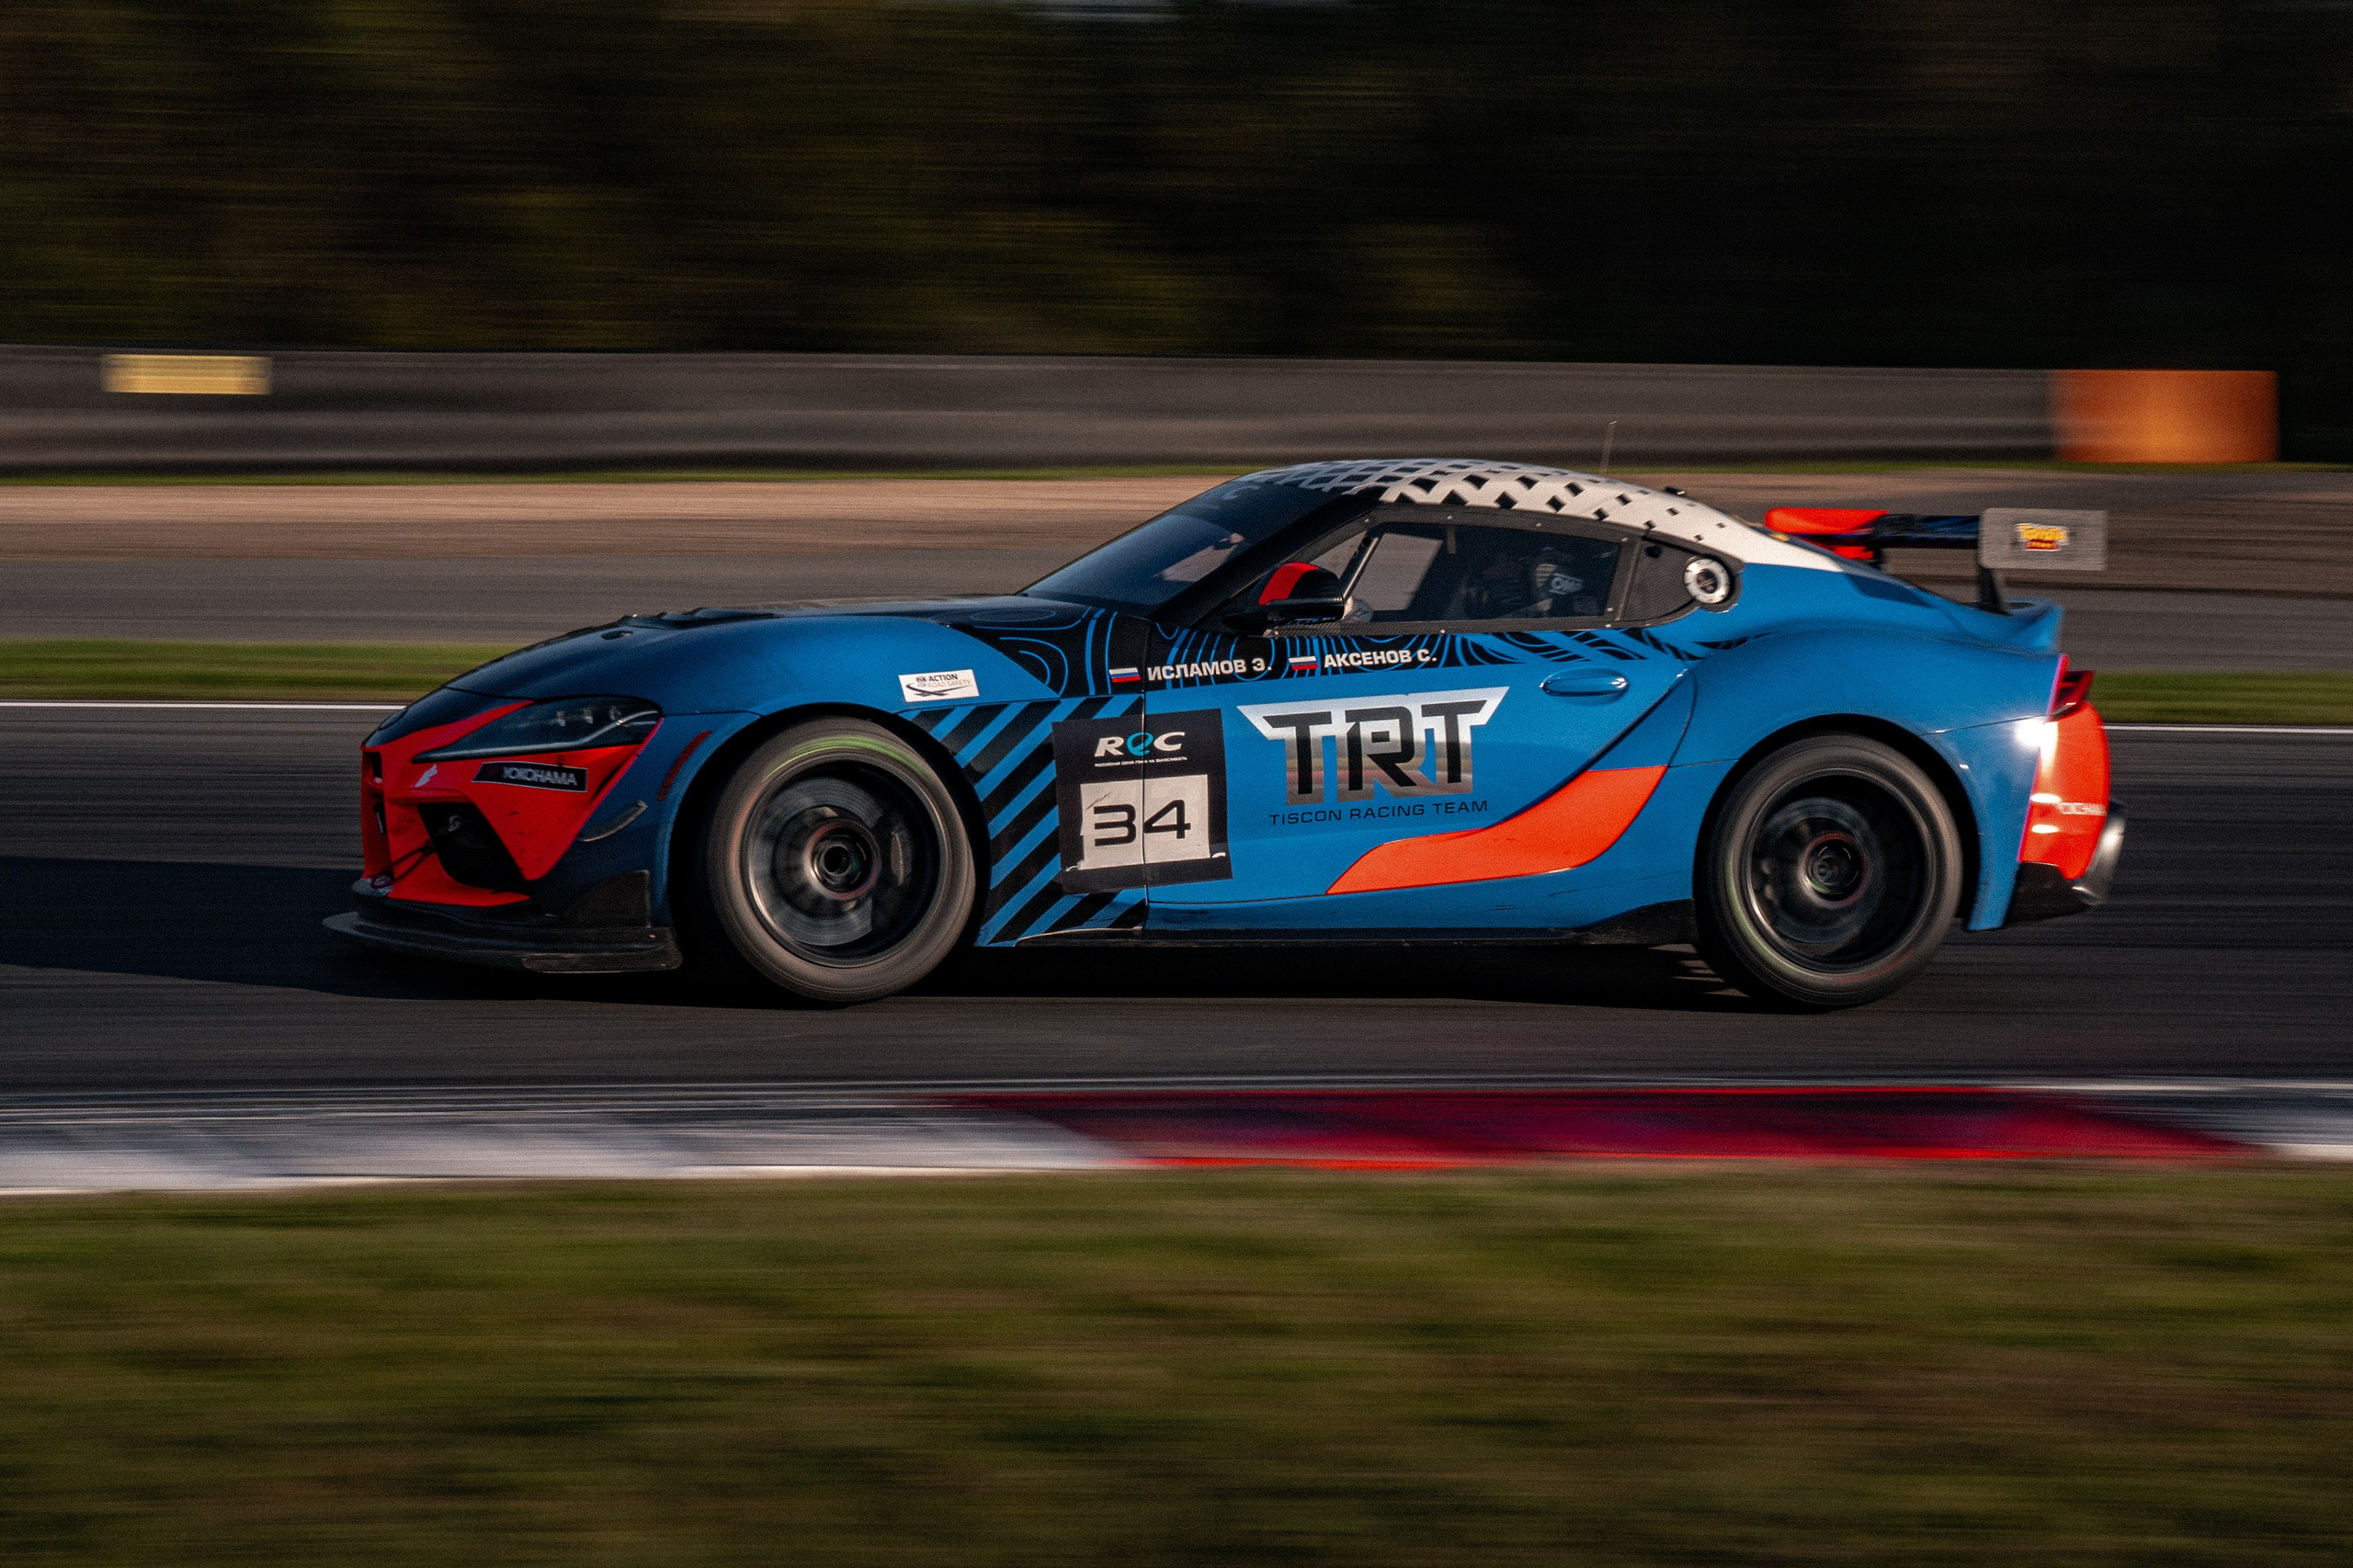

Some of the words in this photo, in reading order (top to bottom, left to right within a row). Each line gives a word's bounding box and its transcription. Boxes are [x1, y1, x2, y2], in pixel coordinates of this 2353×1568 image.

[1147, 658, 1247, 681] ИСЛАМОВ
[1251, 657, 1272, 672] Э.
[1324, 649, 1413, 668] АКСЕНОВ
[1416, 648, 1438, 663] С.
[928, 674, 958, 682] ACTION
[1237, 687, 1508, 804] TRT
[503, 767, 577, 786] YOKOHAMA
[1093, 799, 1191, 846] 34
[1269, 809, 1343, 825] TISCON
[1349, 804, 1426, 820] RACING
[1432, 800, 1488, 814] TEAM
